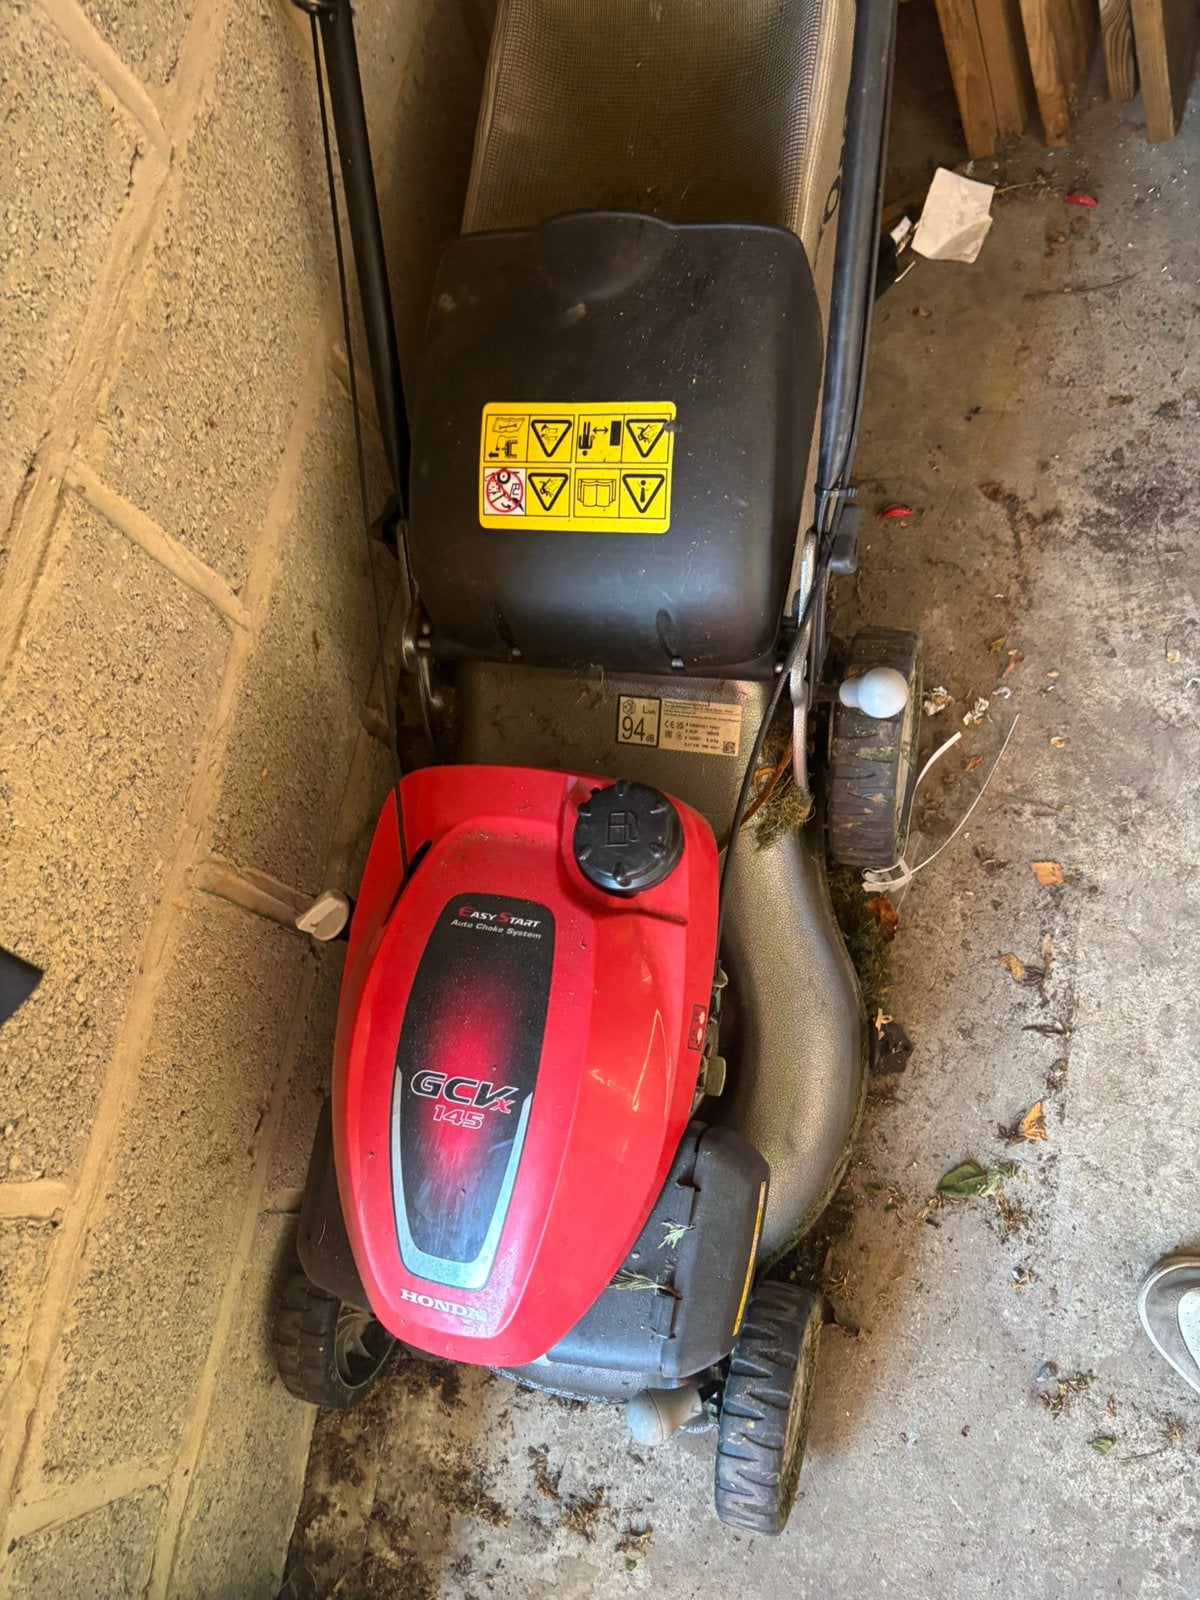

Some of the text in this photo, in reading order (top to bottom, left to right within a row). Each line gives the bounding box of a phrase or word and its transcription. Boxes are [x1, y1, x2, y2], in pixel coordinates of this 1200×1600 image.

[622, 716, 646, 742] 94
[450, 919, 542, 940] Auto Choke System
[458, 906, 542, 928] EASY START
[433, 1104, 485, 1130] 145
[400, 1288, 489, 1321] HONDA
